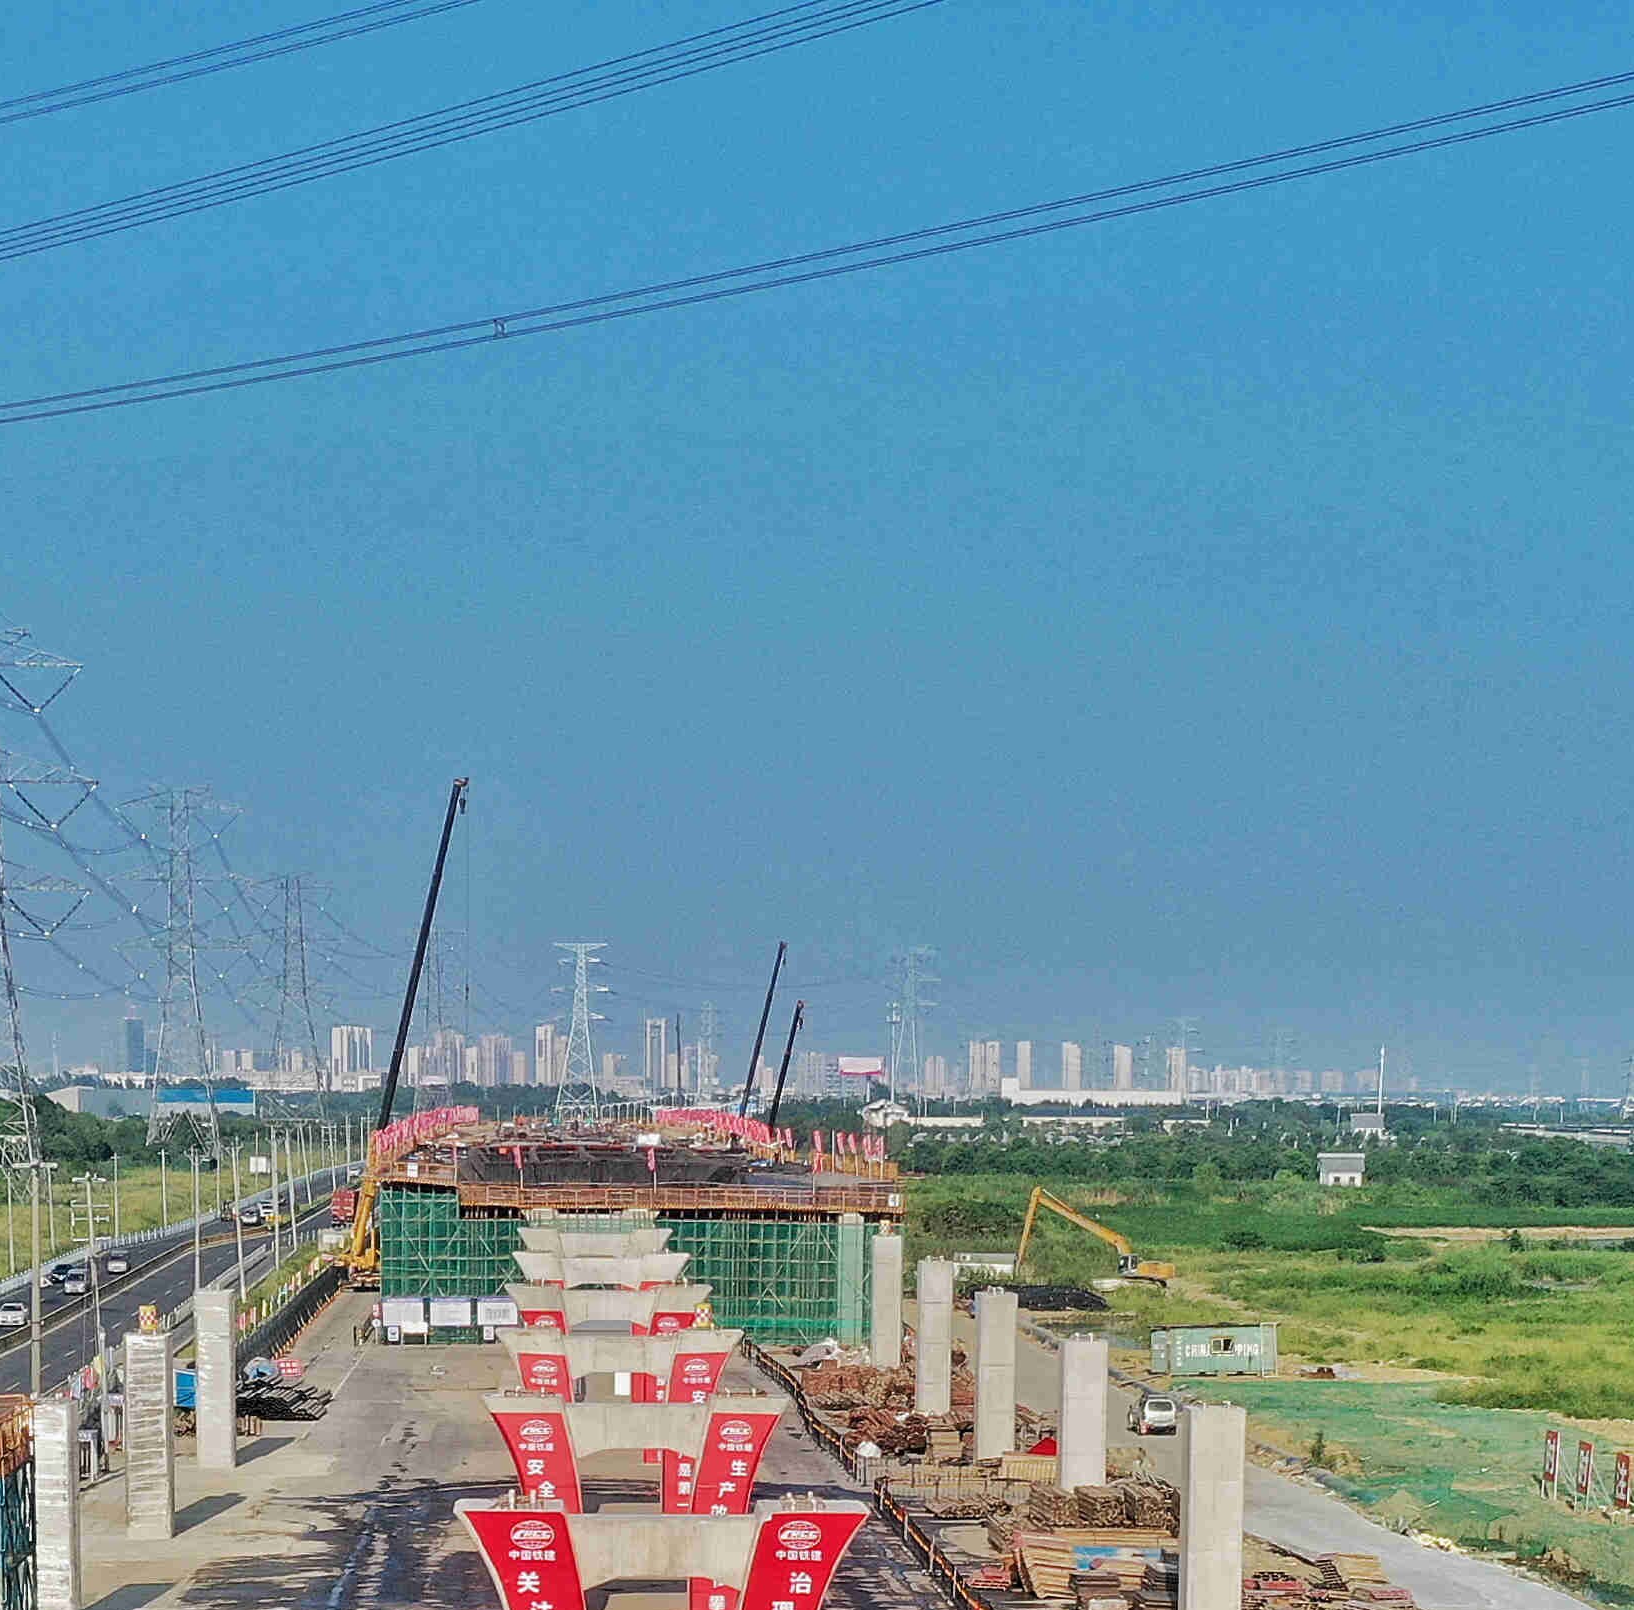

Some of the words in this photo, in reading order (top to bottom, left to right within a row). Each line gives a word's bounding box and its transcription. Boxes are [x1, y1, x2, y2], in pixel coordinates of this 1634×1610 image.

[527, 1459, 557, 1499] 安全
[508, 1549, 556, 1561] 中国铁建
[775, 1549, 822, 1561] 中国铁建
